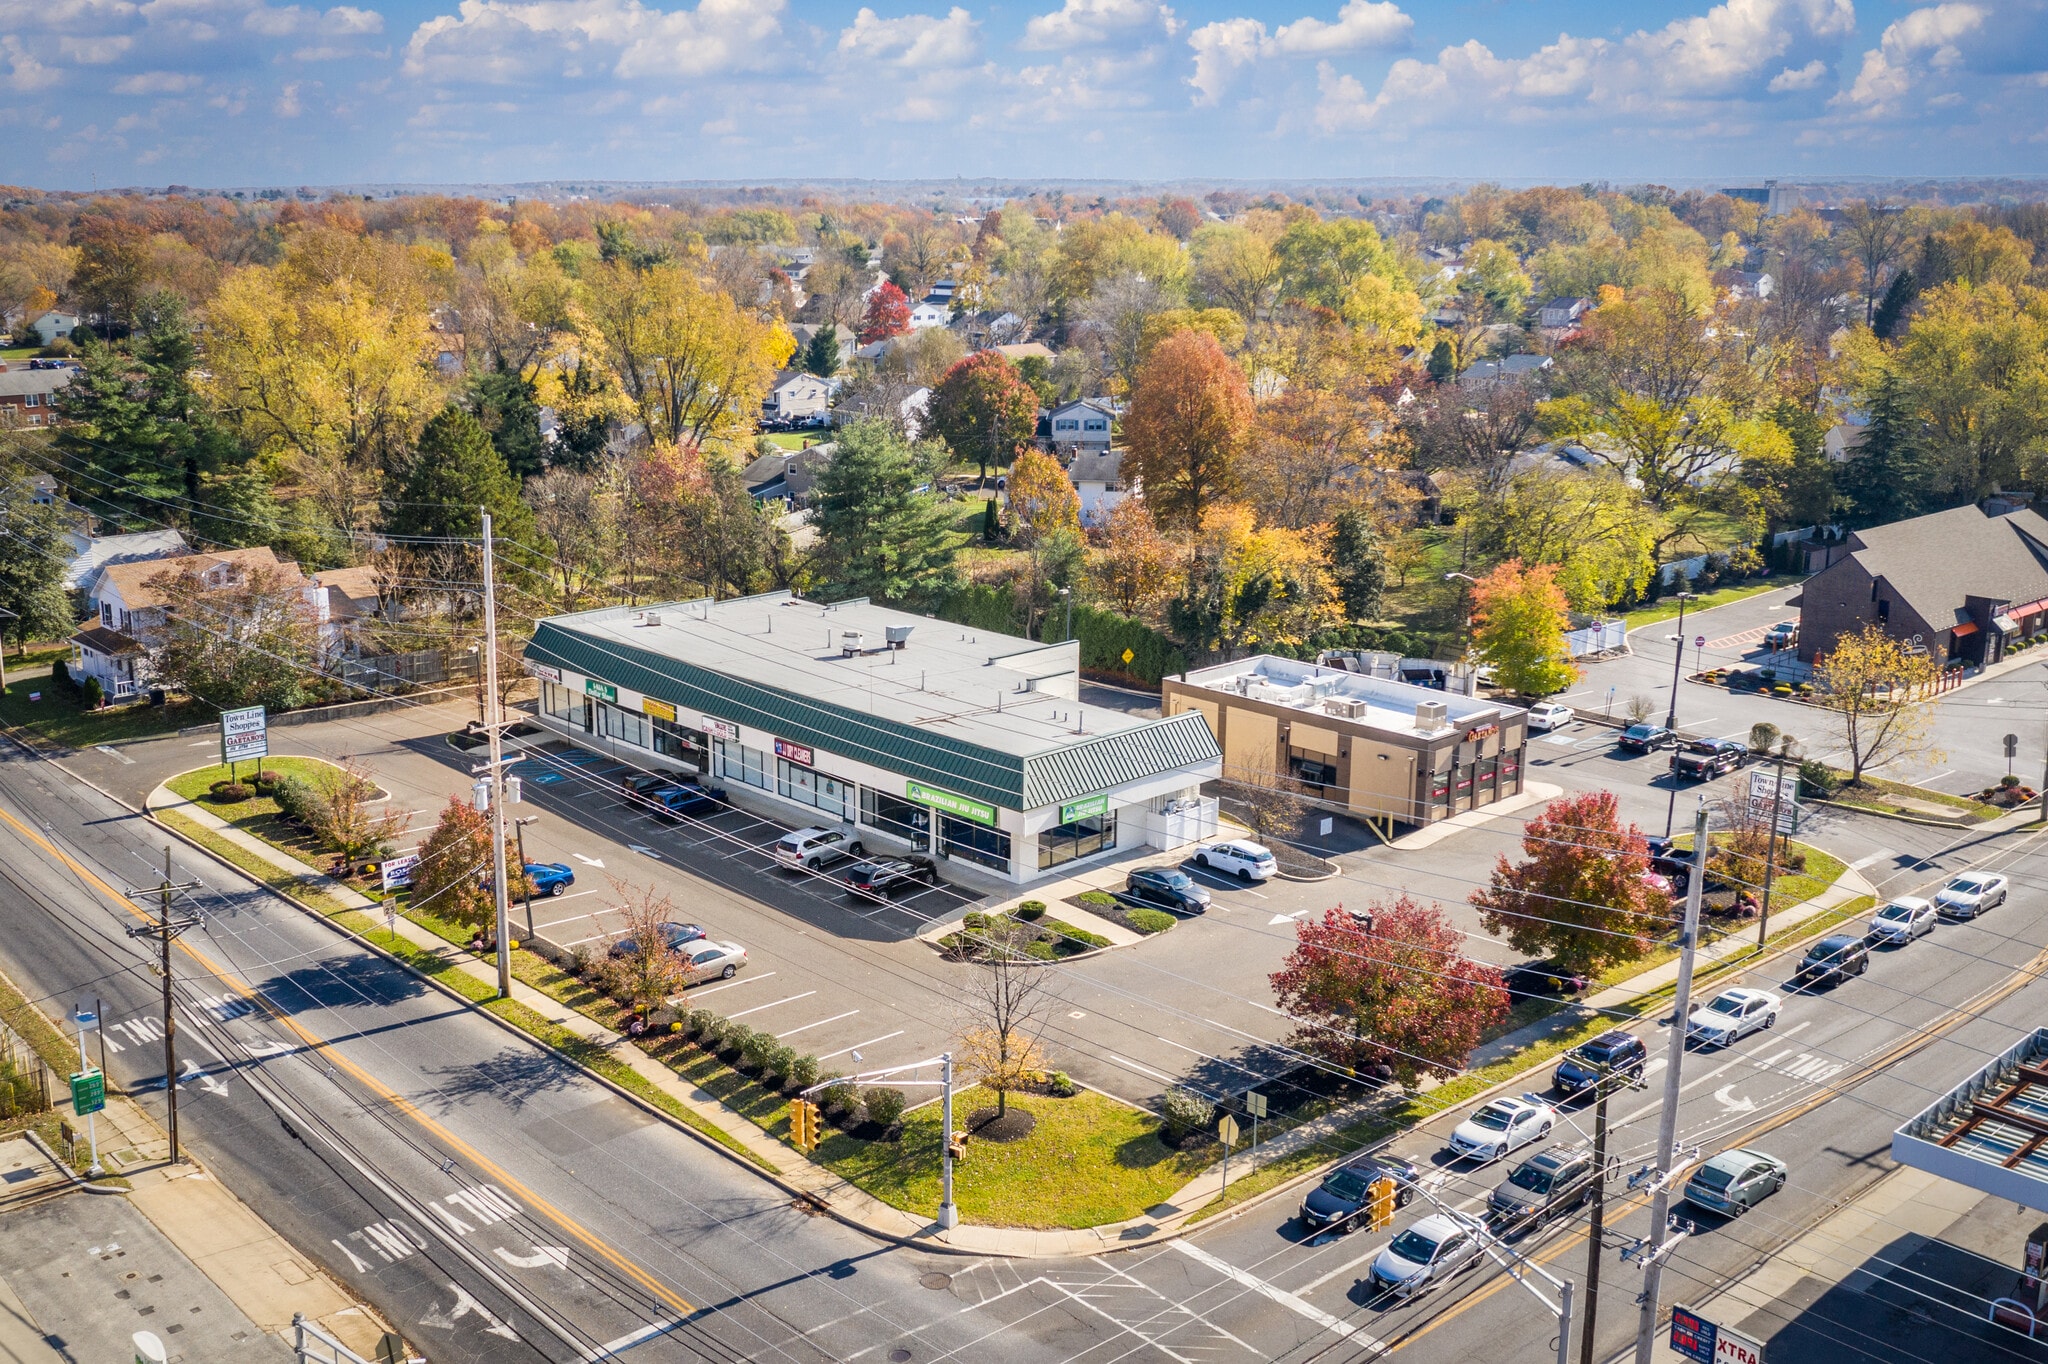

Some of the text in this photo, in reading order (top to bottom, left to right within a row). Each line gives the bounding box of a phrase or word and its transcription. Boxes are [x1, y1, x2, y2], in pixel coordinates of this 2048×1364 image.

[225, 711, 264, 723] Town Line
[229, 720, 260, 731] Shoppes
[1753, 774, 1775, 786] Town
[921, 791, 990, 819] BRAZILIAN JIU JITSU
[1076, 798, 1105, 811] BRAZILIAN
[1078, 805, 1103, 817] JIU JITSU
[95, 1015, 166, 1053] ONLY
[1753, 1049, 1843, 1084] ONLY
[428, 1183, 524, 1236] ONLY
[331, 1218, 429, 1274] ONLY
[1694, 1334, 1711, 1344] CREDIT
[1717, 1338, 1757, 1364] XTRA
[1692, 1354, 1709, 1364] CREDIT
